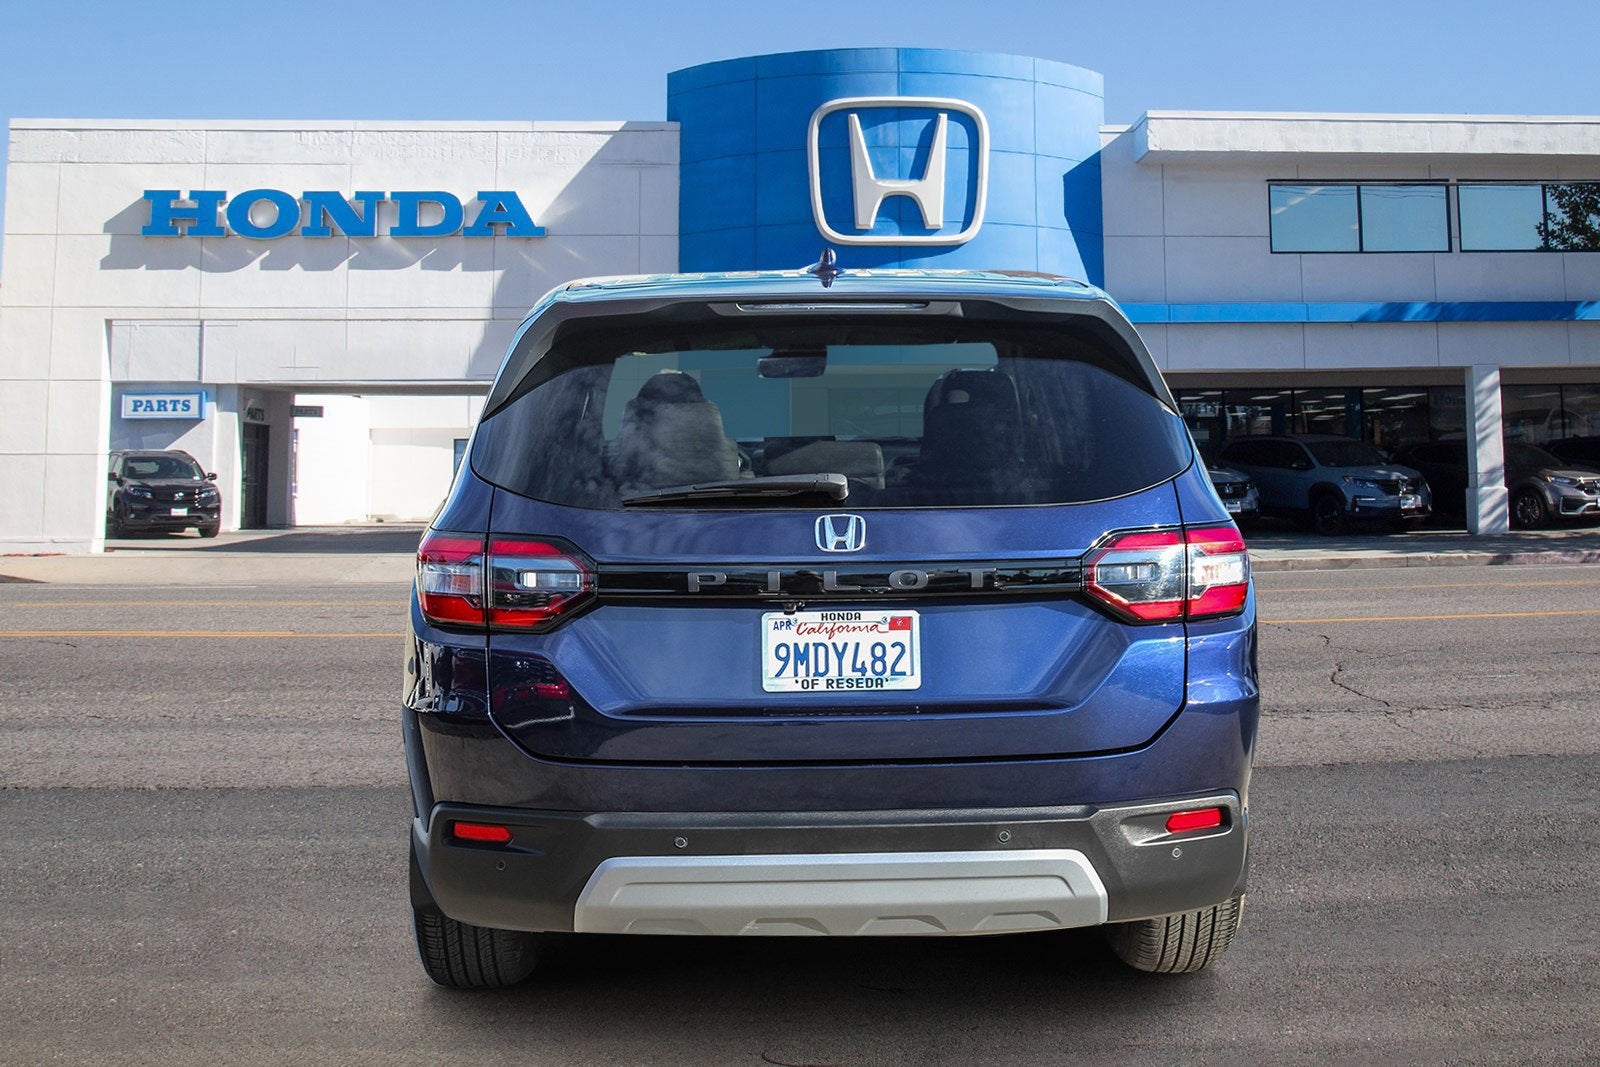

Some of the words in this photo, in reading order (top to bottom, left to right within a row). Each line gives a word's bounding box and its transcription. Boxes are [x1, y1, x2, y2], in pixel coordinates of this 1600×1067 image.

[141, 188, 548, 240] HONDA
[131, 399, 192, 413] PARTS
[687, 567, 997, 592] PILOT
[820, 612, 862, 621] HONDA
[773, 620, 792, 631] APR
[796, 621, 889, 640] California
[774, 642, 907, 678] 9MDY482
[801, 679, 819, 690] OF
[826, 677, 884, 689] RESEDA
